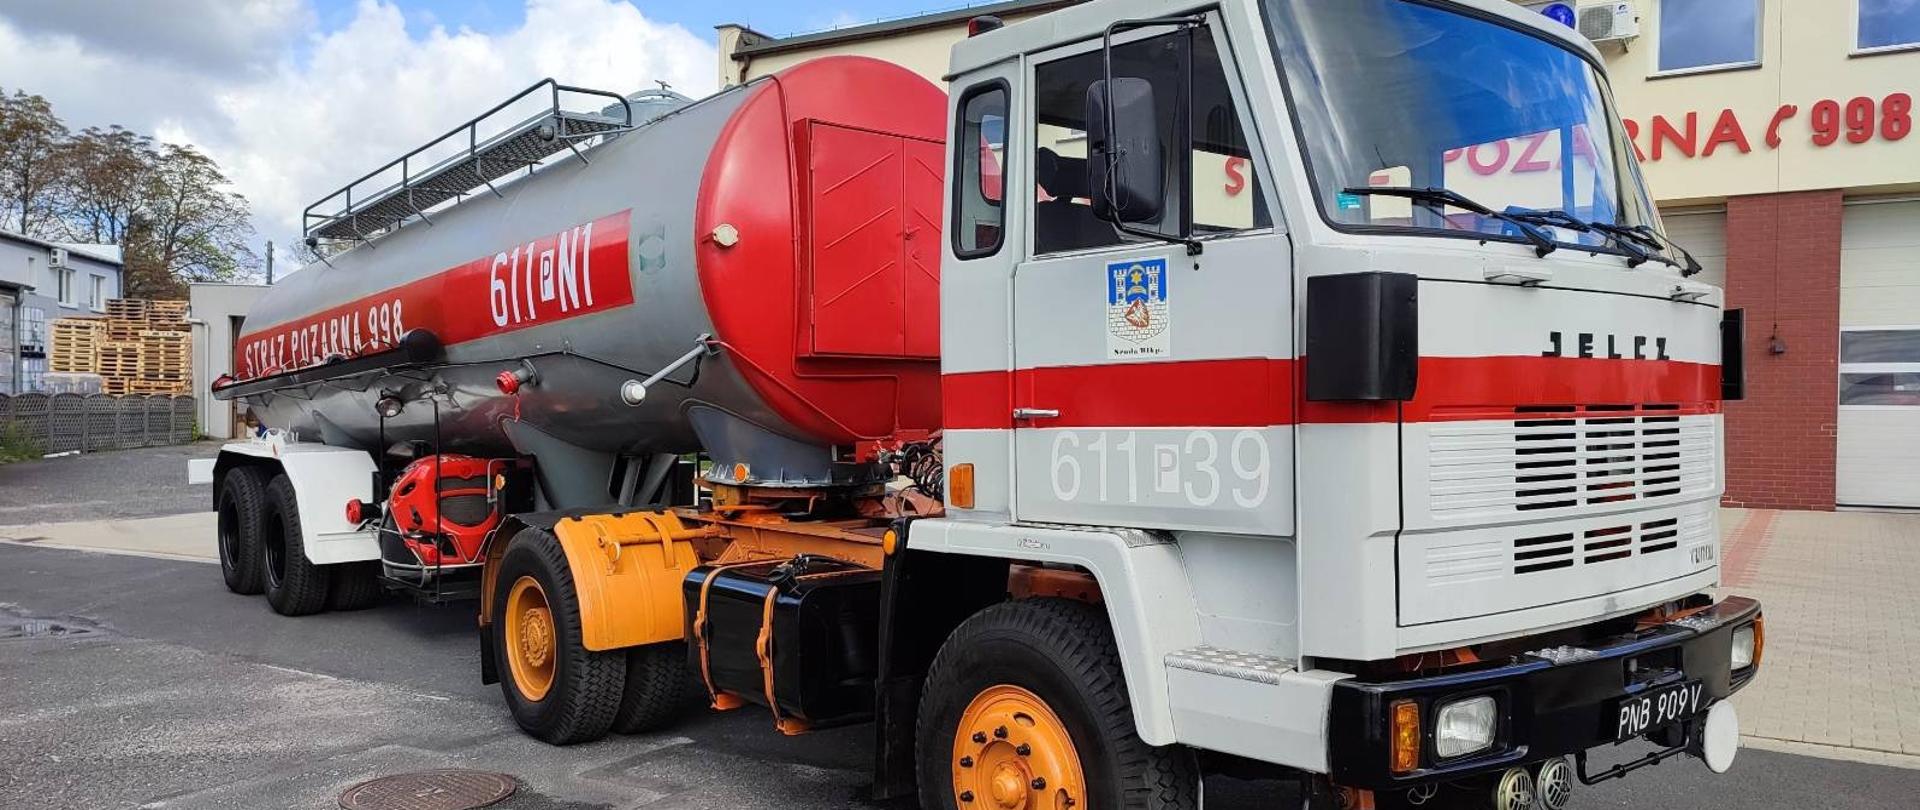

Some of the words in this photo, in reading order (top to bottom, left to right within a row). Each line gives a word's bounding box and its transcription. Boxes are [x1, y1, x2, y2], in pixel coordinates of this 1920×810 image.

[1811, 92, 1912, 147] 998
[368, 299, 404, 349] 998
[1542, 331, 1670, 360] JELCZ
[1617, 697, 1651, 739] PNB
